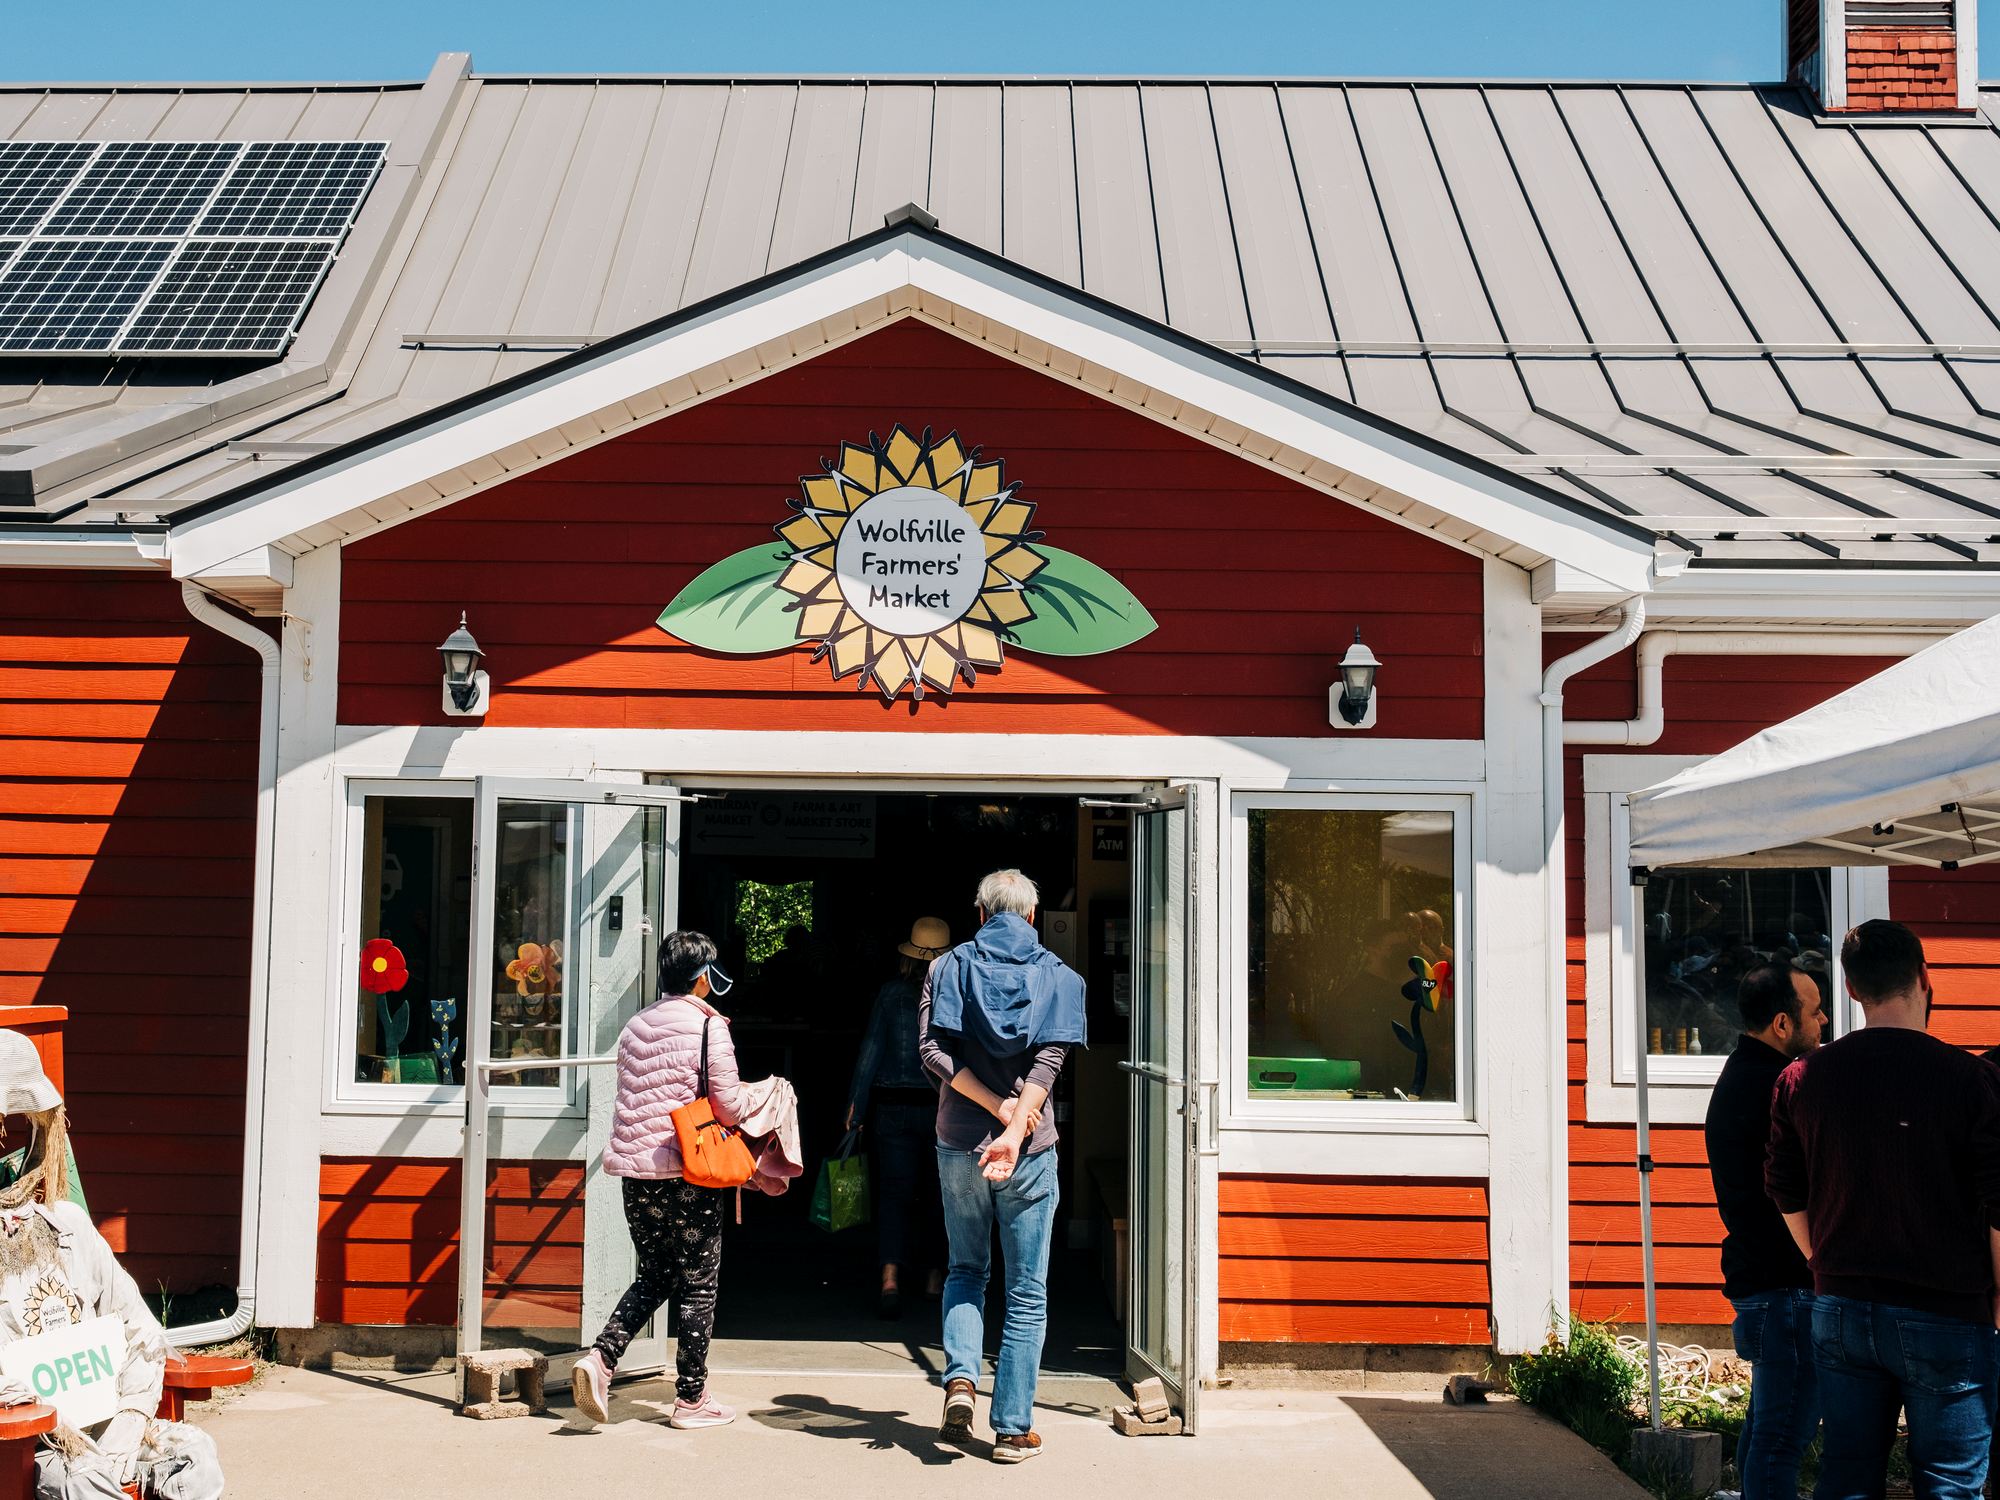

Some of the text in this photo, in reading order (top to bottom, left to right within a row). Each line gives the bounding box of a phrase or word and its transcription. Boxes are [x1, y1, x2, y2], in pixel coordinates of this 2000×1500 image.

[857, 518, 965, 543] Wolfville
[861, 552, 961, 576] Farmers'
[868, 584, 950, 608] Market
[792, 801, 863, 814] FARM & ART
[704, 814, 753, 826] MARKET
[785, 816, 872, 829] MARKET STORE
[1097, 839, 1124, 851] ATM
[32, 1344, 115, 1397] OPEN
